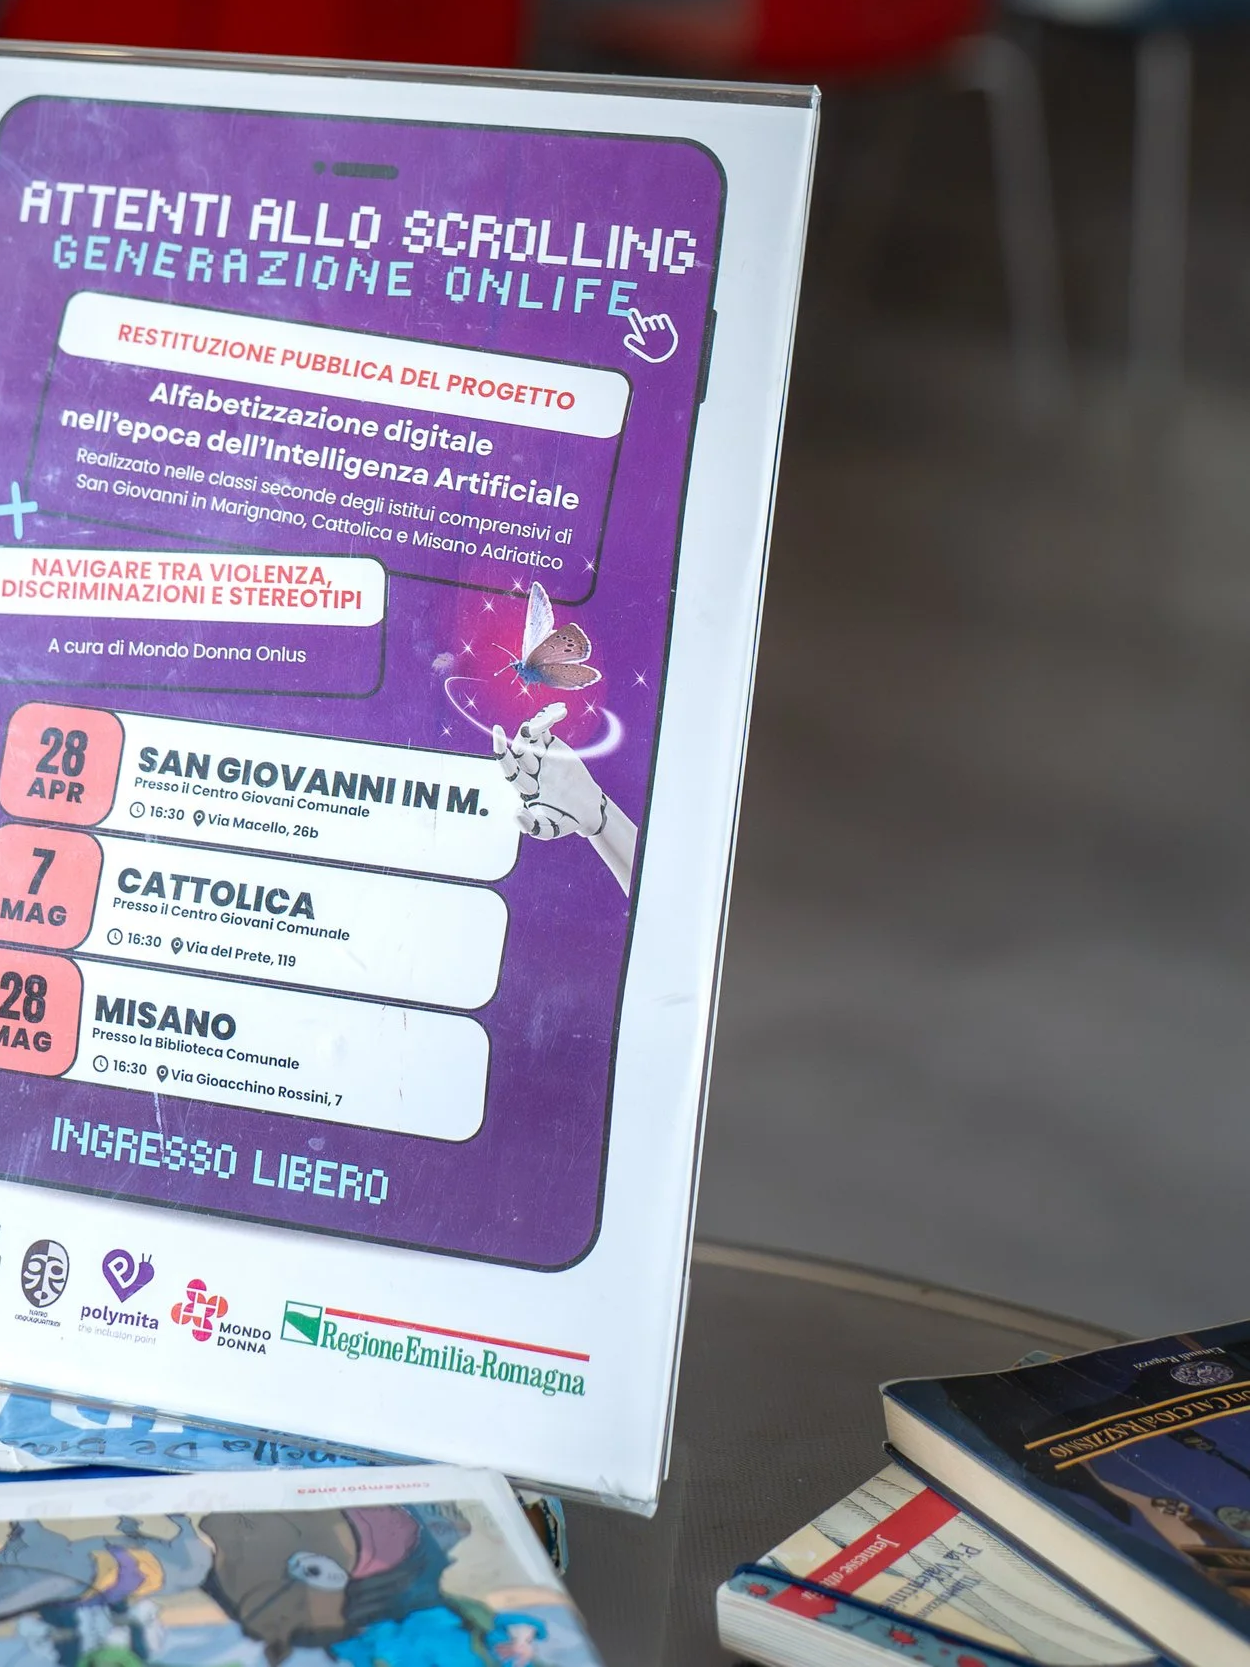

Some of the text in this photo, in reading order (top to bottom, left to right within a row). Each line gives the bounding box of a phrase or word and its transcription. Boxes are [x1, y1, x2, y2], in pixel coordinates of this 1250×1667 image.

[20, 180, 697, 274] ATTENTI ALLO SCROLLING
[53, 235, 639, 317] GENERAZIONE ONLIFE
[118, 323, 576, 410] RESTITUZIONE PUBBLICA DEL PROGETTO
[149, 382, 494, 456] Alfabetizzazione digitale
[60, 408, 580, 511] nell'epoca dell'Intelligenza Artificiale
[76, 447, 572, 545] Realizzato nelle classi seconde degli istitui comprensivi di
[76, 474, 563, 570] San Giovanni in Marignano, Cattolica e Misano Adriatico
[1, 579, 362, 610] DISCRIMINAZIONI E STEREOTIPI
[31, 558, 332, 589] NAVIGARE TRA VIOLENZA,
[47, 638, 307, 664] A cura di Mondo Donna Onlus
[35, 726, 88, 777] 28
[26, 776, 85, 803] APR
[134, 776, 370, 819] Presso il Centro Giovani Comunale
[138, 746, 490, 818] SAN GIOVANNI IN M.
[150, 804, 319, 840] 16:30 Via Macello, 26b
[26, 847, 56, 896] 7
[117, 867, 316, 920] CATTOLICA
[0, 899, 67, 927] MAG
[112, 897, 350, 941] Presso il Centro Giovani Comunale
[127, 931, 297, 968] 16:30 Via del Prete, 119
[94, 994, 237, 1041] MISANO
[92, 1027, 300, 1071] Presso la Biblioteca Comunale
[113, 1059, 343, 1107] 16:30 Via Gioacchino Rossini, 7
[51, 1117, 389, 1205] INGRESSO LIBERO
[80, 1305, 159, 1330] polymita
[219, 1322, 272, 1341] MONDO
[216, 1337, 267, 1355] DONNA
